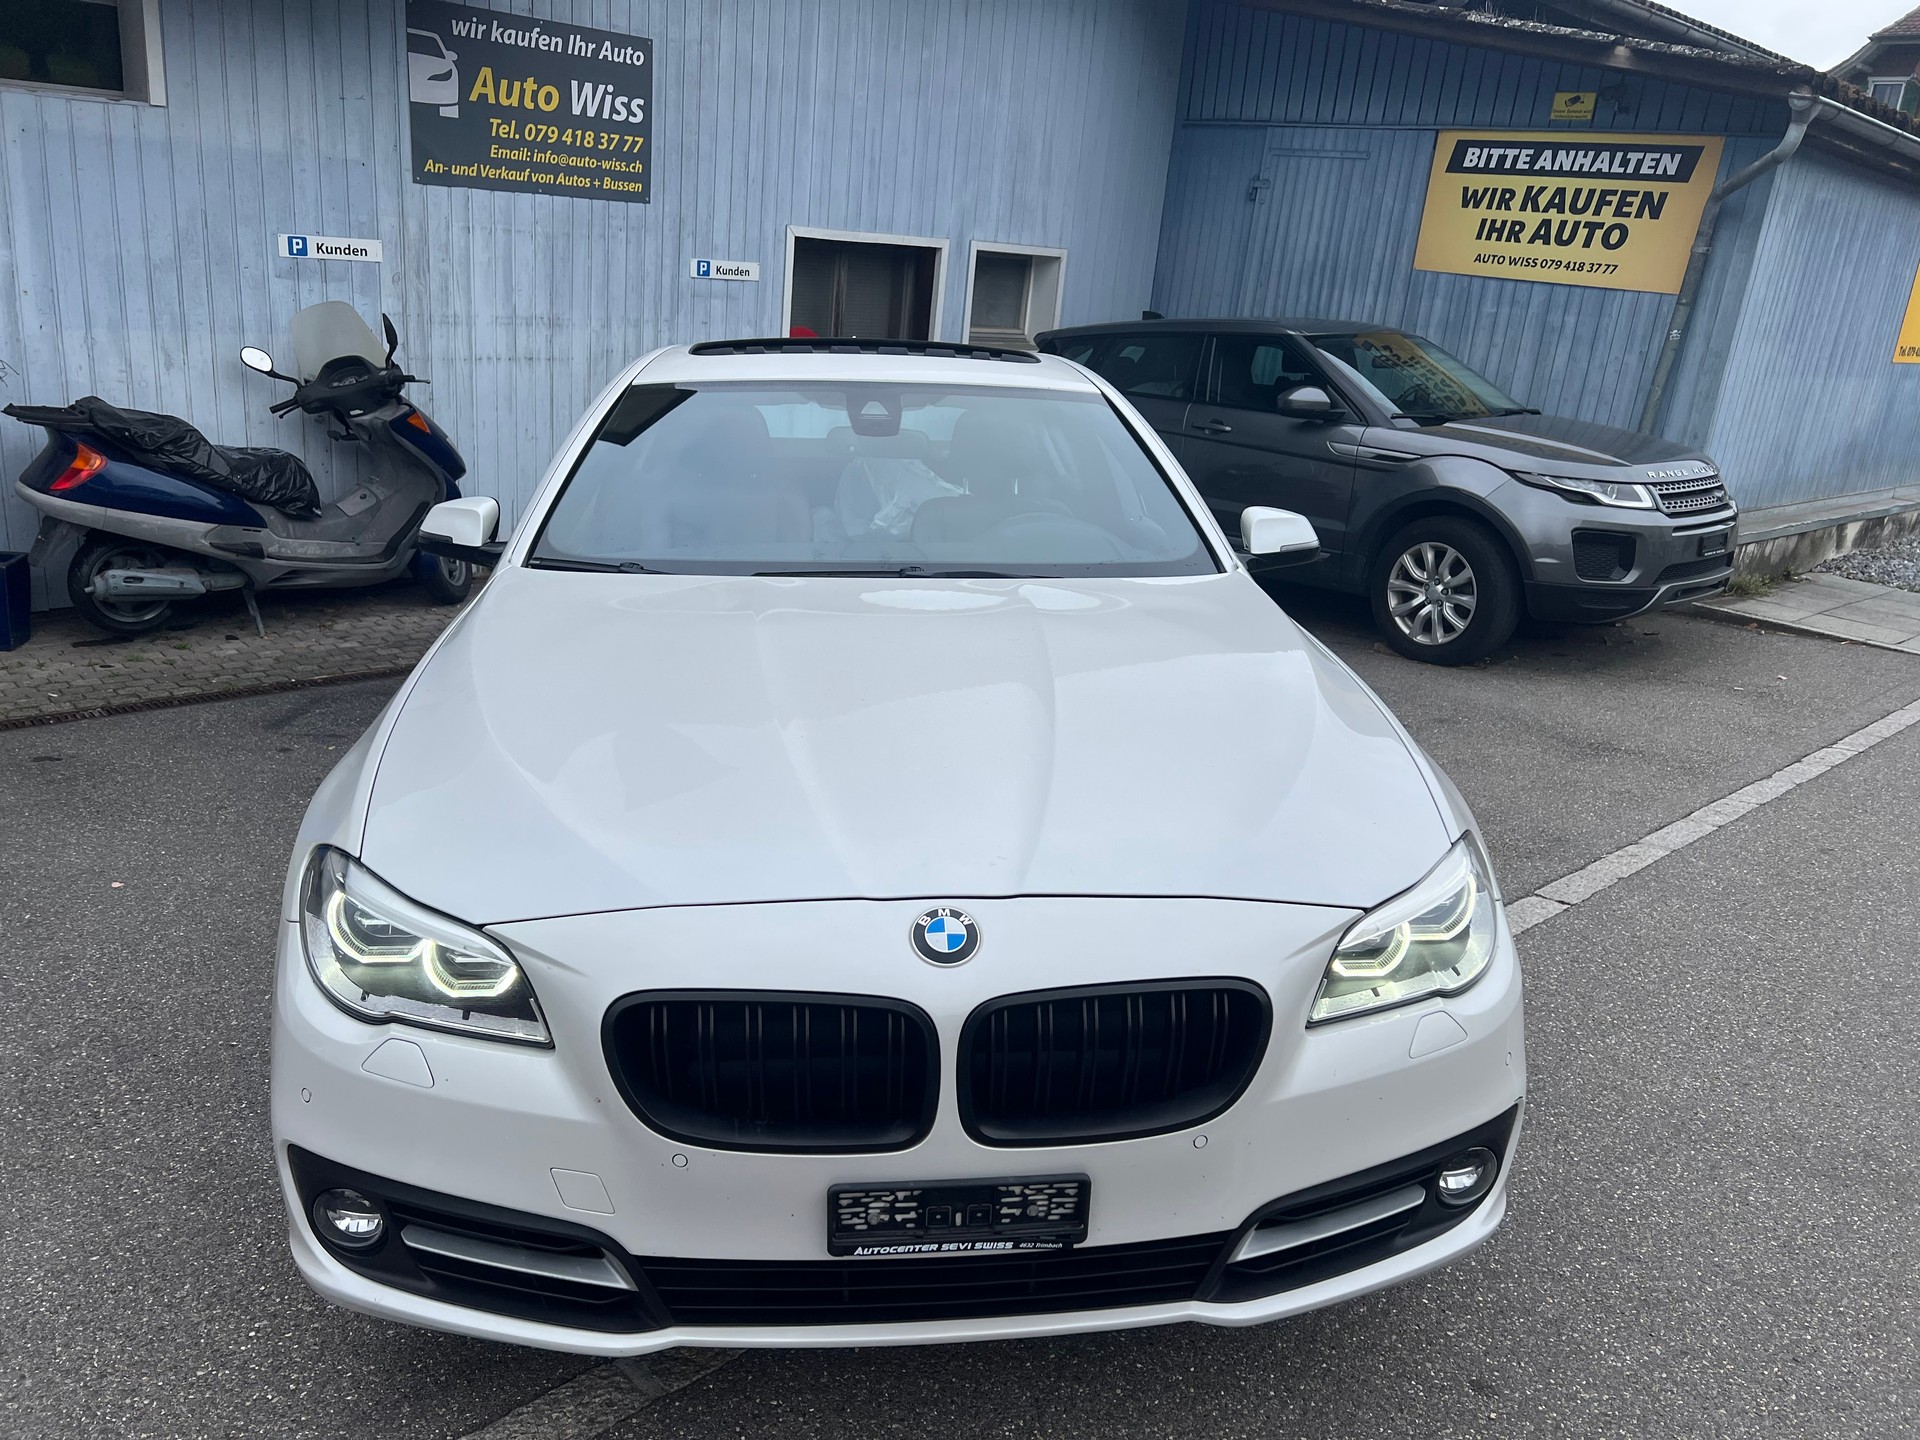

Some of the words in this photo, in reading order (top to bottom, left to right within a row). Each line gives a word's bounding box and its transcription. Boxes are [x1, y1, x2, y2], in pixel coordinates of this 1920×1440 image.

[451, 18, 487, 40] wir
[491, 20, 562, 52] kaufen
[567, 34, 596, 58] Ihr
[599, 41, 645, 66] Auto
[468, 66, 560, 112] Auto
[570, 79, 645, 124] Wiss
[489, 118, 520, 140] Tel.
[524, 123, 559, 143] 079
[561, 127, 594, 148] 418
[597, 132, 623, 151] 37
[623, 135, 644, 154] 77
[490, 144, 531, 162] Email:
[533, 146, 643, 174] info@auto-wiss.ch
[1463, 147, 1534, 171] BITTE
[1533, 149, 1682, 176] ANHALTEN
[424, 159, 449, 173] An-
[451, 162, 477, 177] und
[480, 164, 530, 183] Verkauf
[531, 170, 554, 184] von
[555, 172, 591, 188] Autos
[602, 177, 643, 193] Bussen
[1460, 186, 1517, 212] WIR
[1518, 185, 1669, 220] KAUFEN
[1475, 218, 1526, 243] IHR
[1527, 218, 1629, 250] AUTO
[316, 242, 368, 257] Kunden
[1473, 253, 1507, 266] AUTO
[1508, 255, 1539, 269] WISS
[1539, 258, 1562, 271] 079
[1562, 260, 1585, 273] 418
[1586, 262, 1602, 274] 37
[1602, 263, 1619, 275] 77
[716, 265, 750, 277] Kunden
[1646, 468, 1689, 479] RANGE
[917, 908, 973, 927] BMW
[853, 1243, 938, 1256] AUTOCENTER
[940, 1242, 973, 1252] SEVI
[973, 1241, 1014, 1250] SWISS
